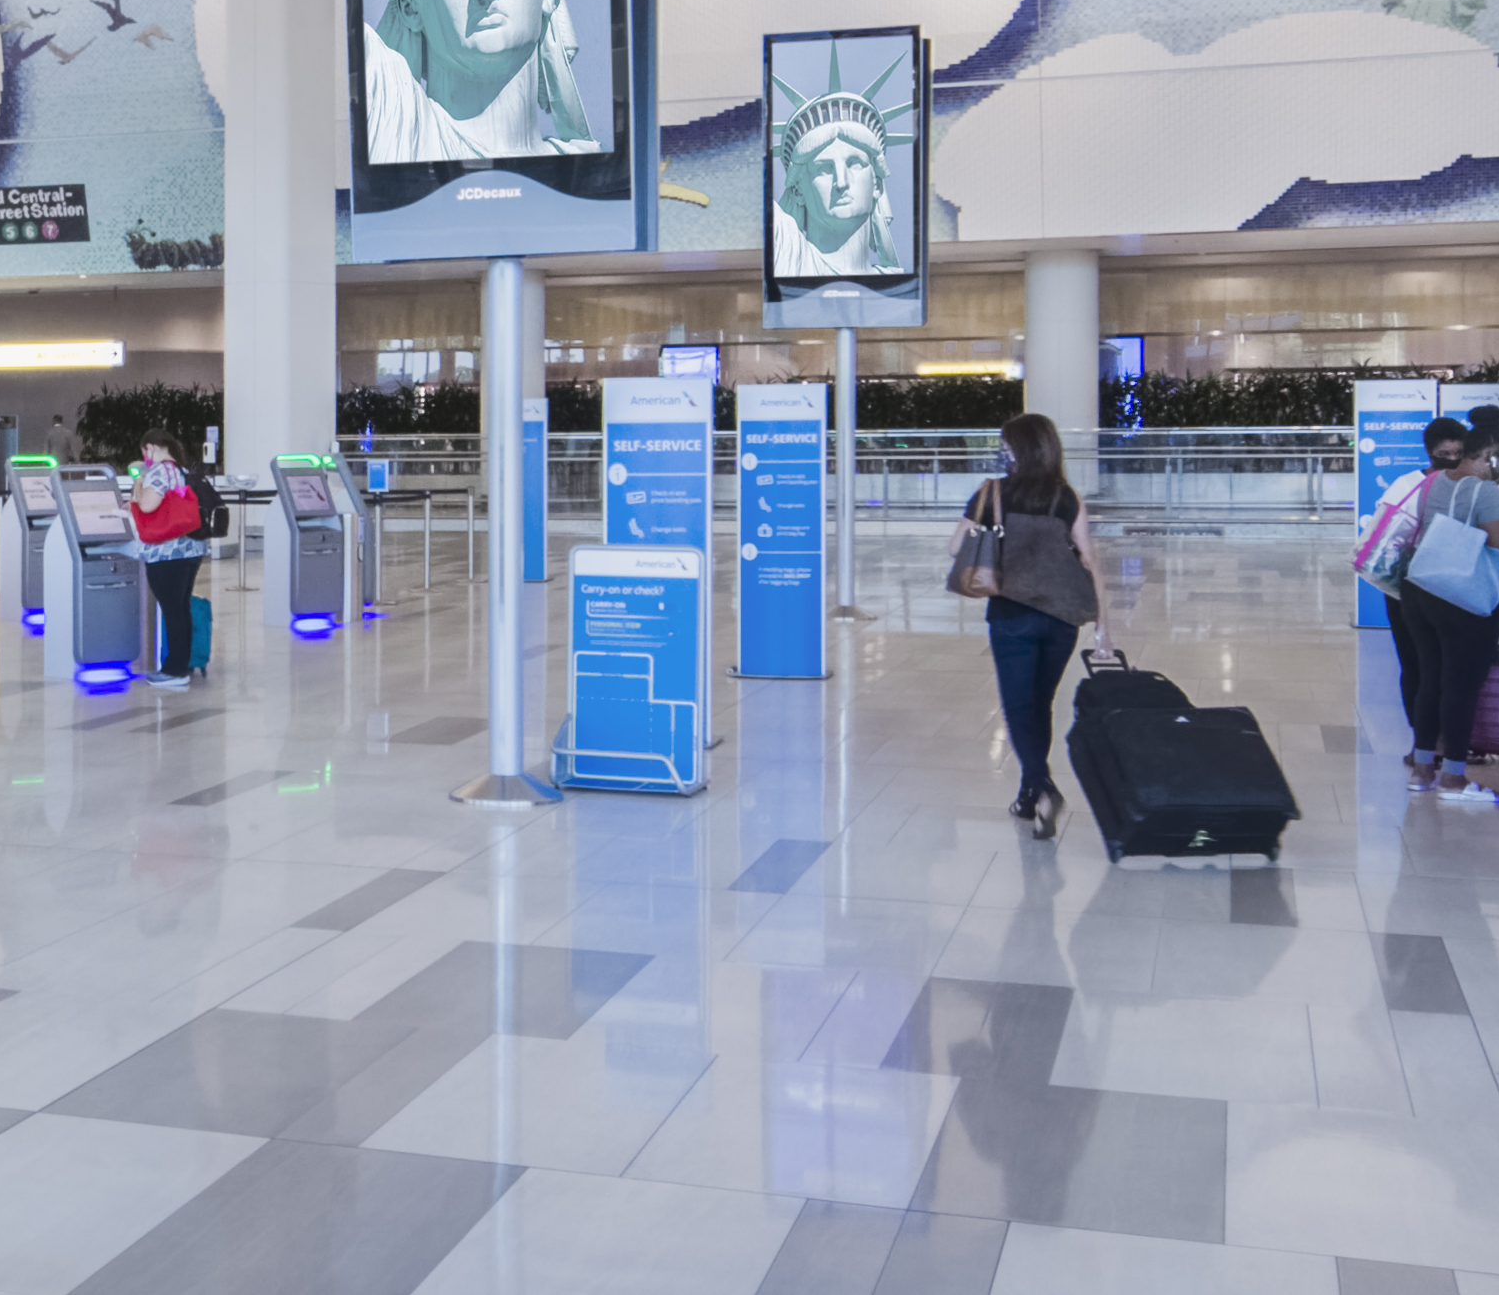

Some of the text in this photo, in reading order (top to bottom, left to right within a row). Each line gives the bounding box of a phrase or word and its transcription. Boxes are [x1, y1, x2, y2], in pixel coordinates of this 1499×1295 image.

[7, 186, 73, 204] Central-
[456, 187, 522, 201] JCDecaux
[30, 202, 84, 218] Station
[6, 226, 15, 239] 5
[25, 225, 35, 238] 6
[46, 224, 54, 236] 7
[631, 396, 681, 405] American
[1378, 392, 1416, 400] American
[746, 433, 819, 444] SELF-SERVICE
[613, 439, 702, 452] SELF-SERVICE
[635, 560, 676, 568] American
[581, 584, 664, 596] Carry-on or check?
